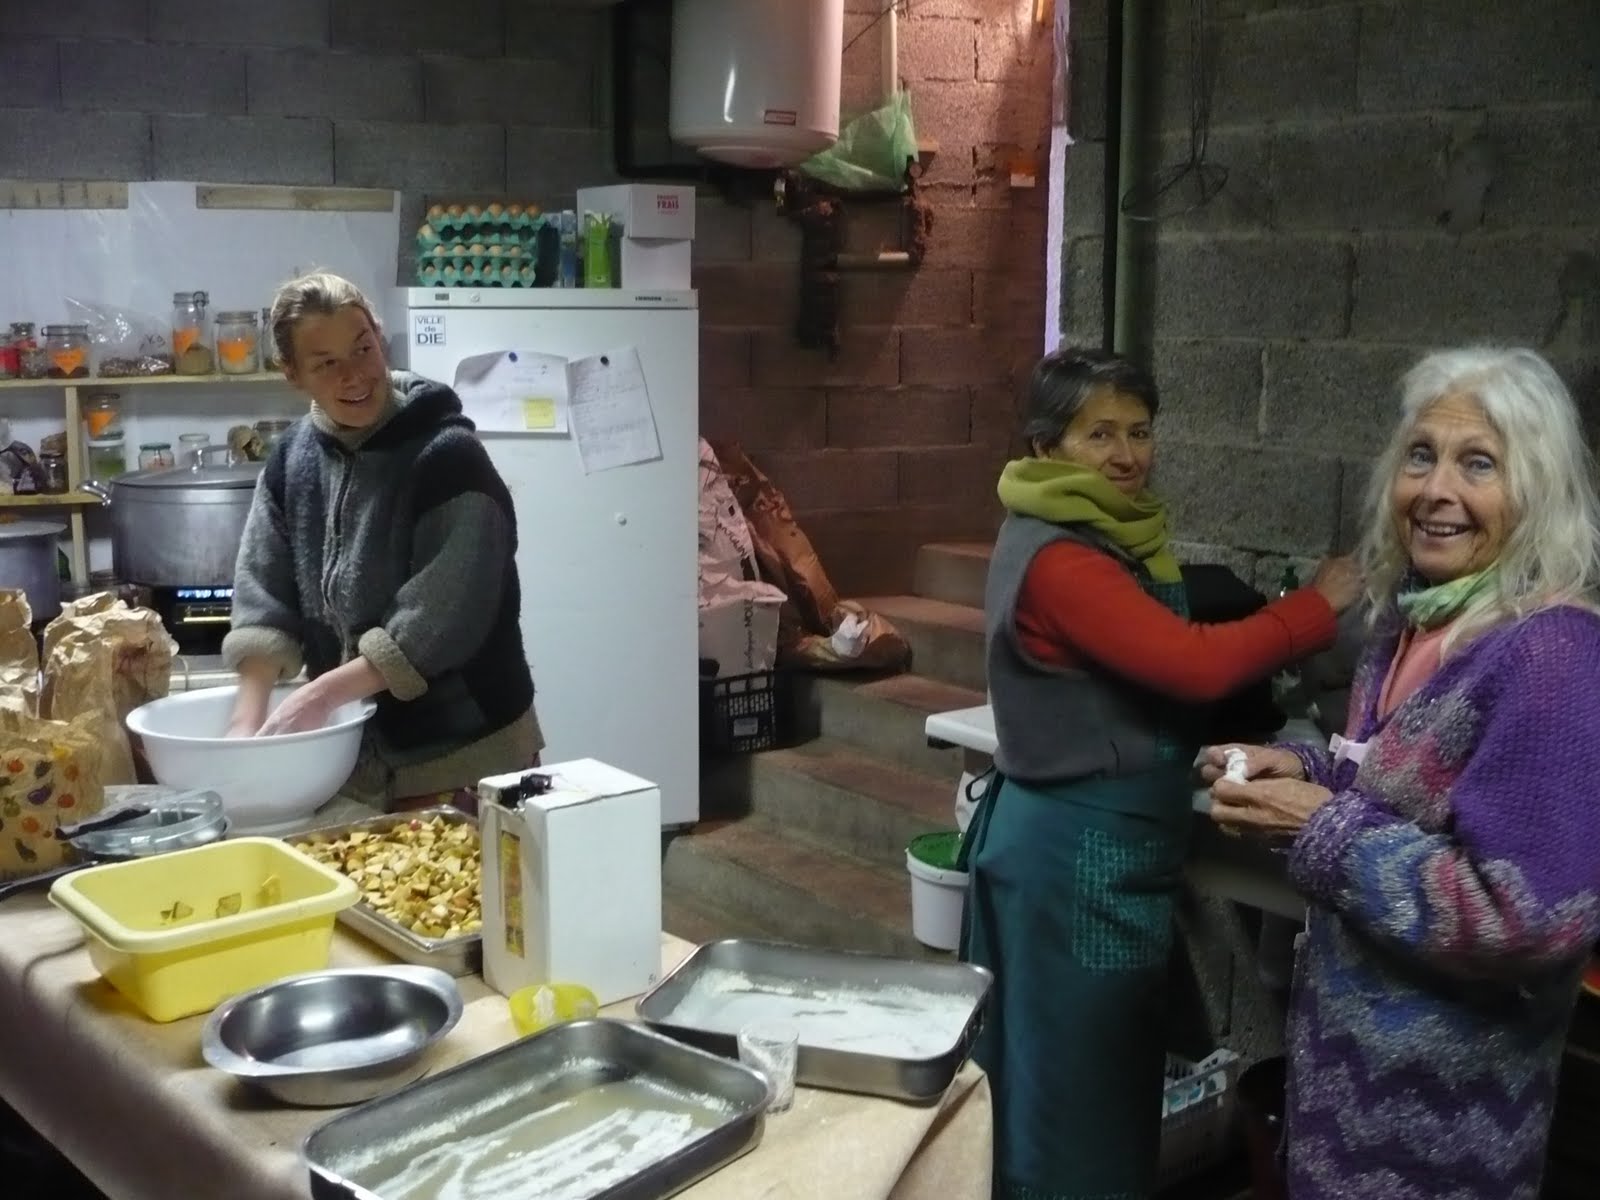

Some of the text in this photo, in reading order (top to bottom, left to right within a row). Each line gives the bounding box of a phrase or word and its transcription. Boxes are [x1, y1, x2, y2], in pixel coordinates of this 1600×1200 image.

[657, 200, 679, 209] FRAIS
[417, 316, 443, 325] VILLE
[417, 333, 443, 344] DIE
